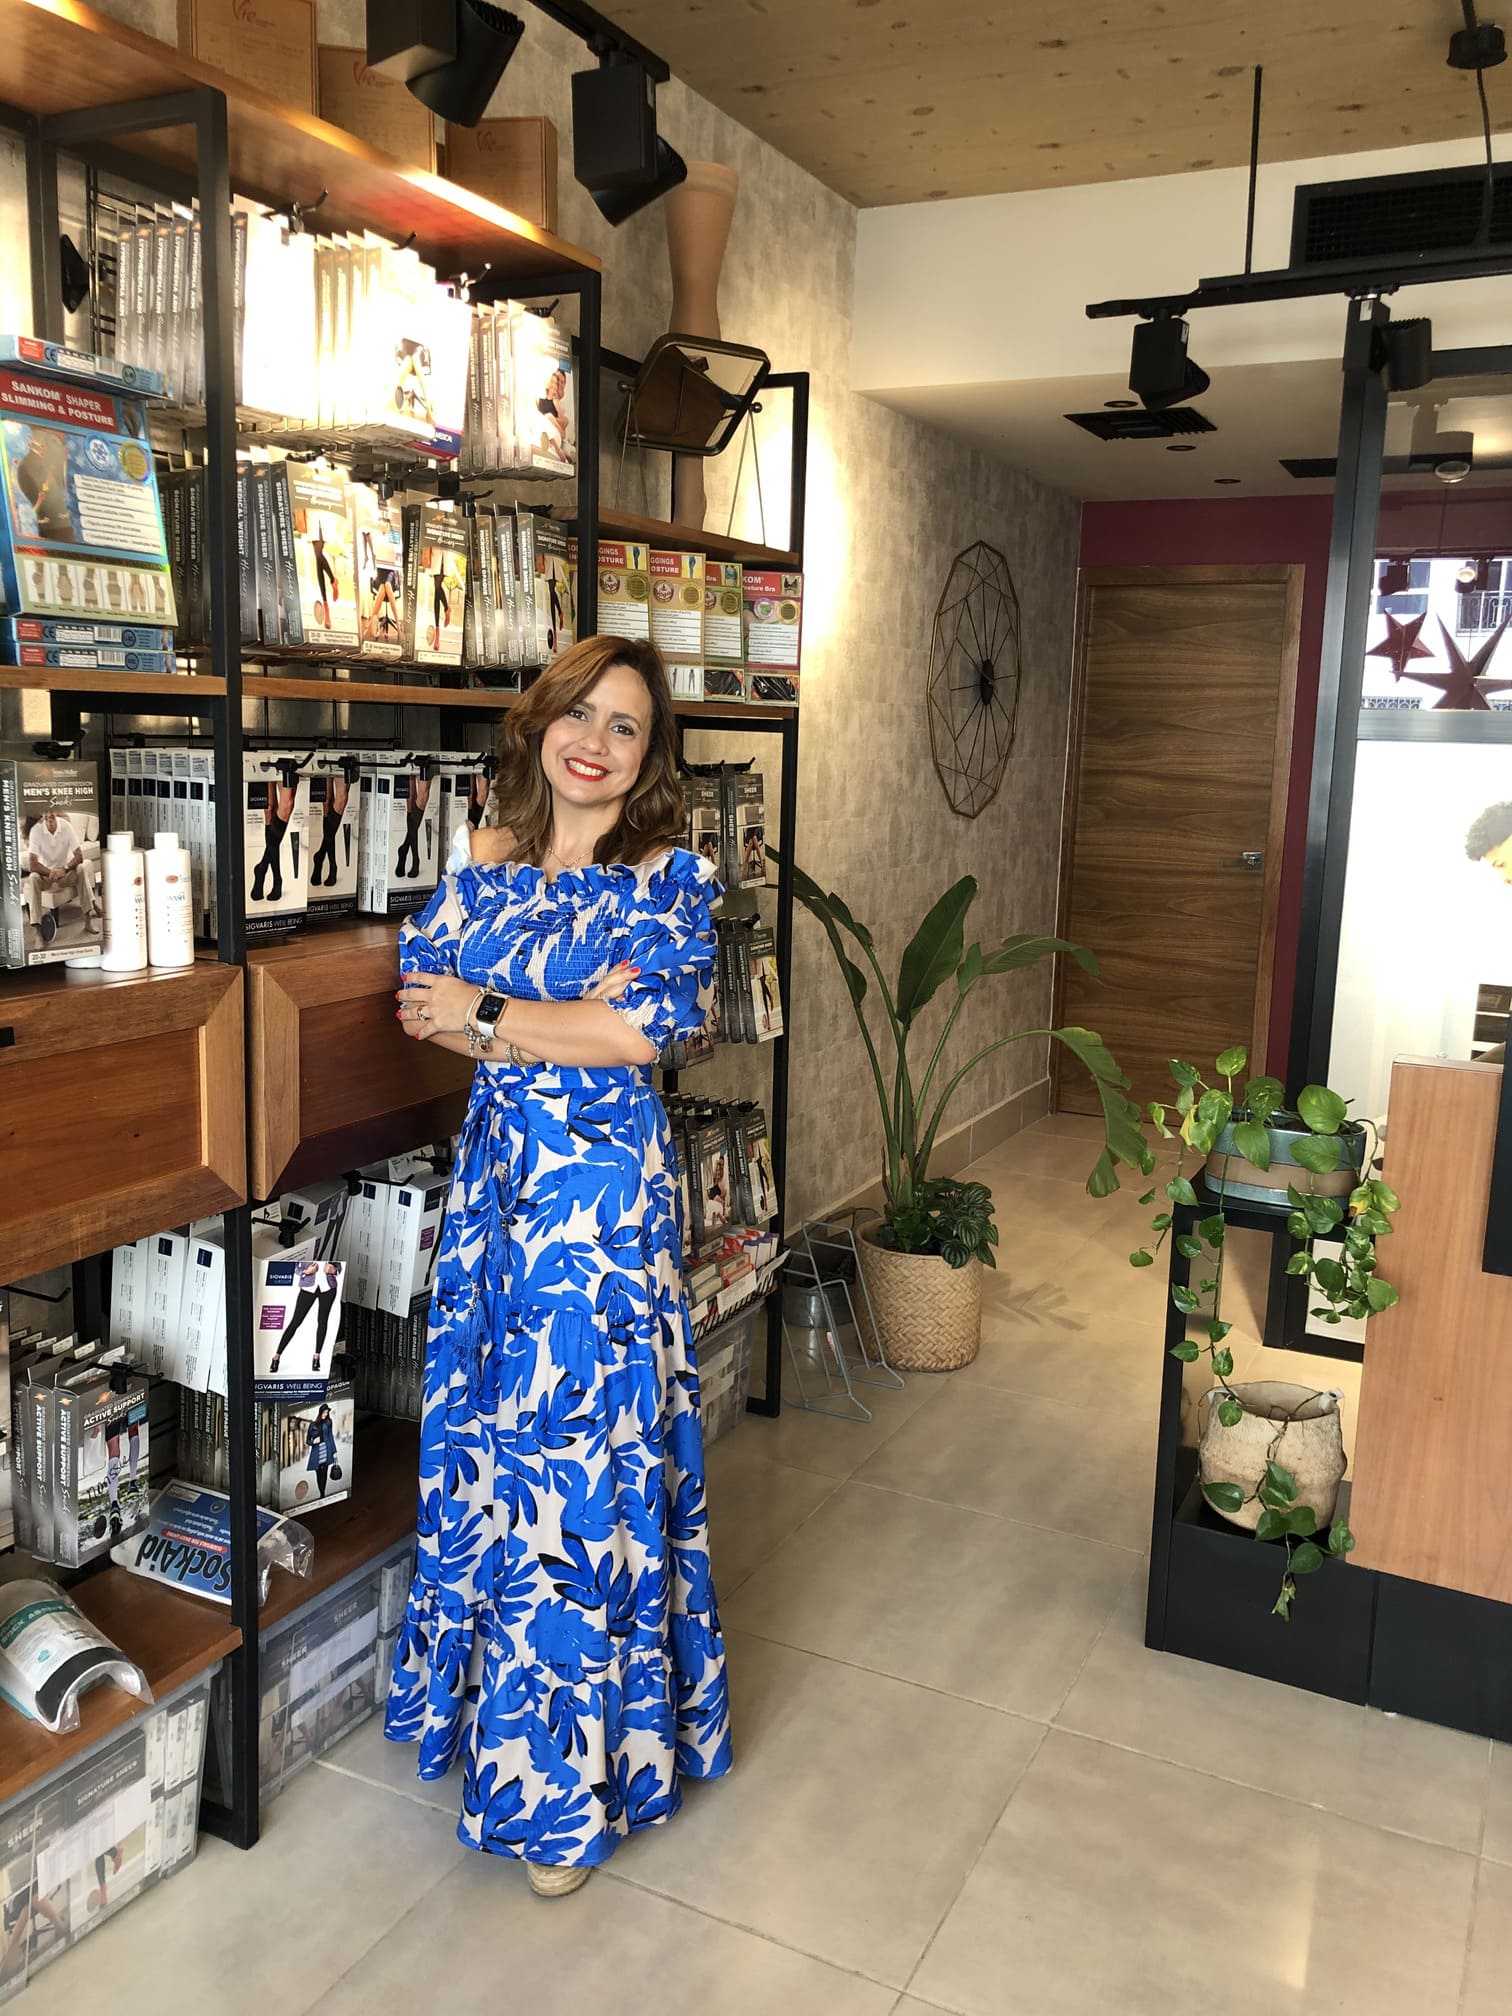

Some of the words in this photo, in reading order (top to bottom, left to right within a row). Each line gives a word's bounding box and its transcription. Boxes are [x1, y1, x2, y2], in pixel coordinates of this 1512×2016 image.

[1, 393, 55, 412] SLIMMING
[58, 406, 66, 415] &
[68, 408, 114, 426] POSTURE
[11, 381, 61, 400] SANKOM
[66, 394, 102, 412] SHAPER
[276, 482, 285, 528] SIGNATURE
[598, 547, 619, 555] GINGS
[651, 565, 680, 574] OSTURE
[2, 780, 10, 812] MEN'S
[6, 873, 18, 906] Socks
[246, 920, 273, 930] SIGVARIS
[287, 917, 303, 925] BEING
[308, 904, 328, 913] IGVARIS
[84, 1409, 112, 1426] ACTIVE
[113, 1392, 145, 1413] SUPPORT
[135, 1534, 231, 1592] SockAid
[334, 1602, 358, 1623] SHEER
[8, 1817, 43, 1848] SHEER
